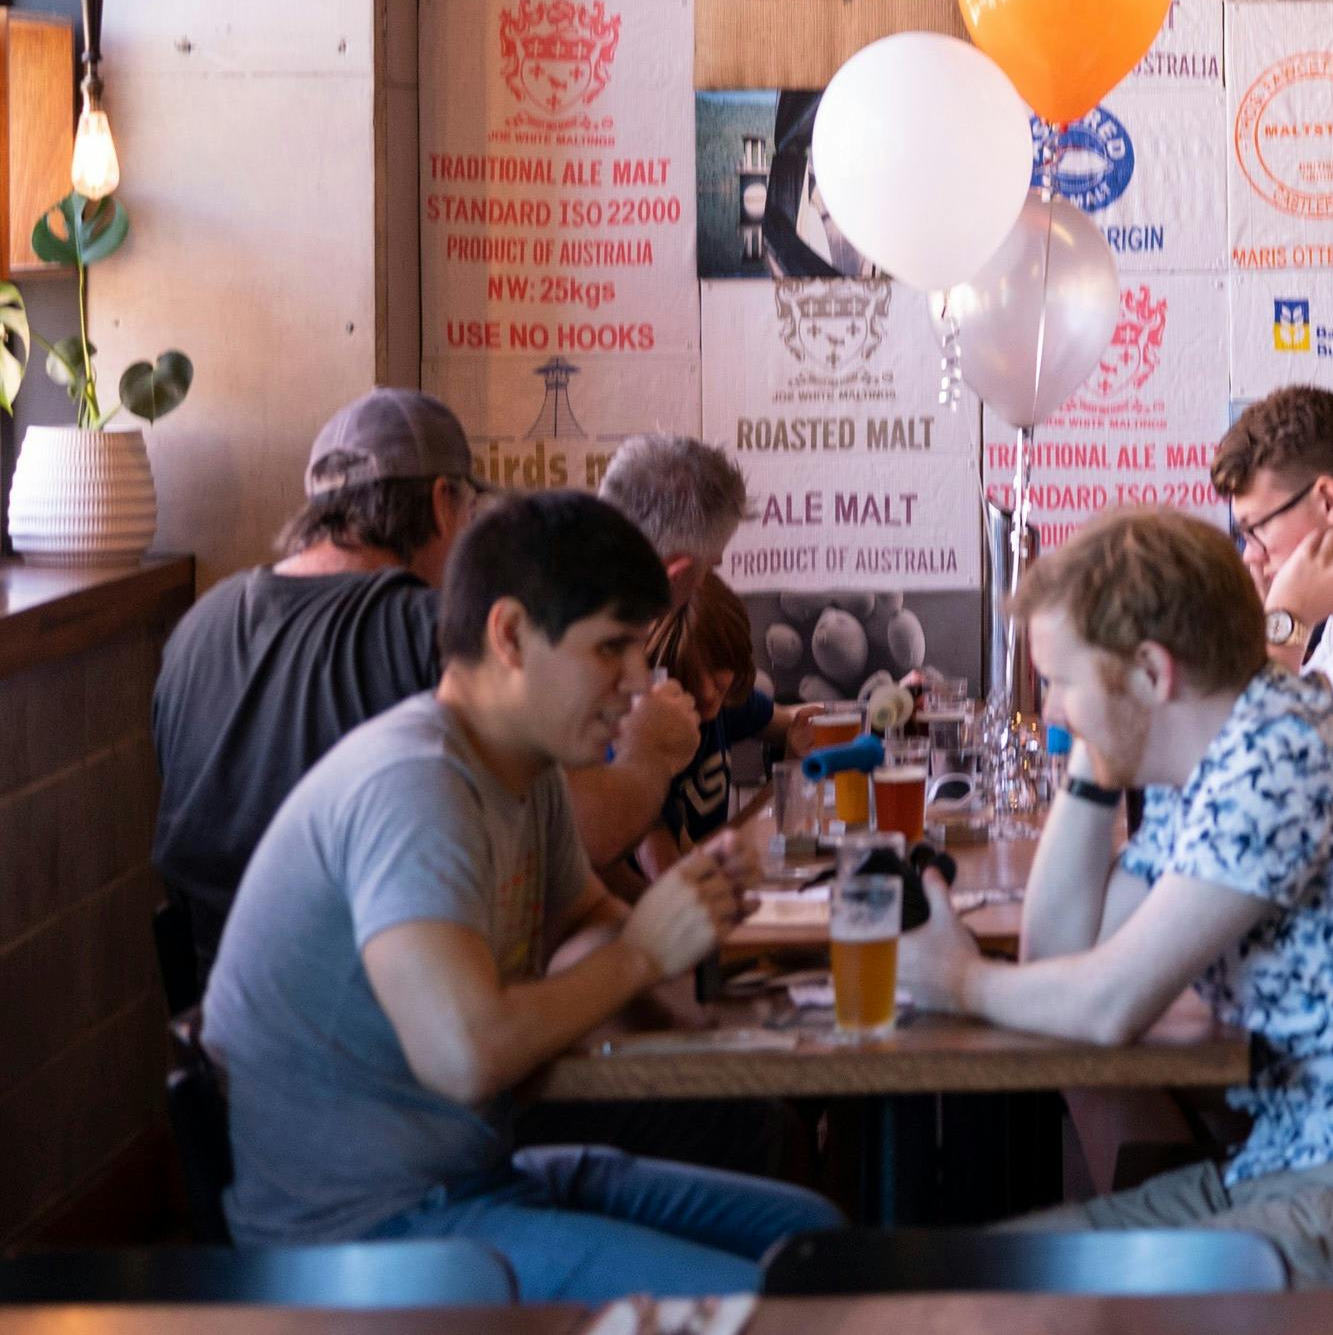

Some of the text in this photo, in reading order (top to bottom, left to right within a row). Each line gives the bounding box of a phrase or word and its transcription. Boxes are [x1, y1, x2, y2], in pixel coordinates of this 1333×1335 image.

[515, 133, 552, 145] WHITE
[556, 135, 616, 146] MALTINGS
[429, 155, 671, 187] TRADITIONAL ALE MALT
[427, 197, 680, 228] STANDARD ISO 22000
[447, 237, 653, 265] PRODUCT OF AUSTRALIA
[1232, 247, 1287, 267] MARIS
[447, 322, 655, 351] USE NO HOOKS
[738, 416, 934, 452] ROASTED MALT
[762, 492, 918, 527] ALE MALT
[731, 547, 958, 577] PRODUCT OF AUSTRALIA
